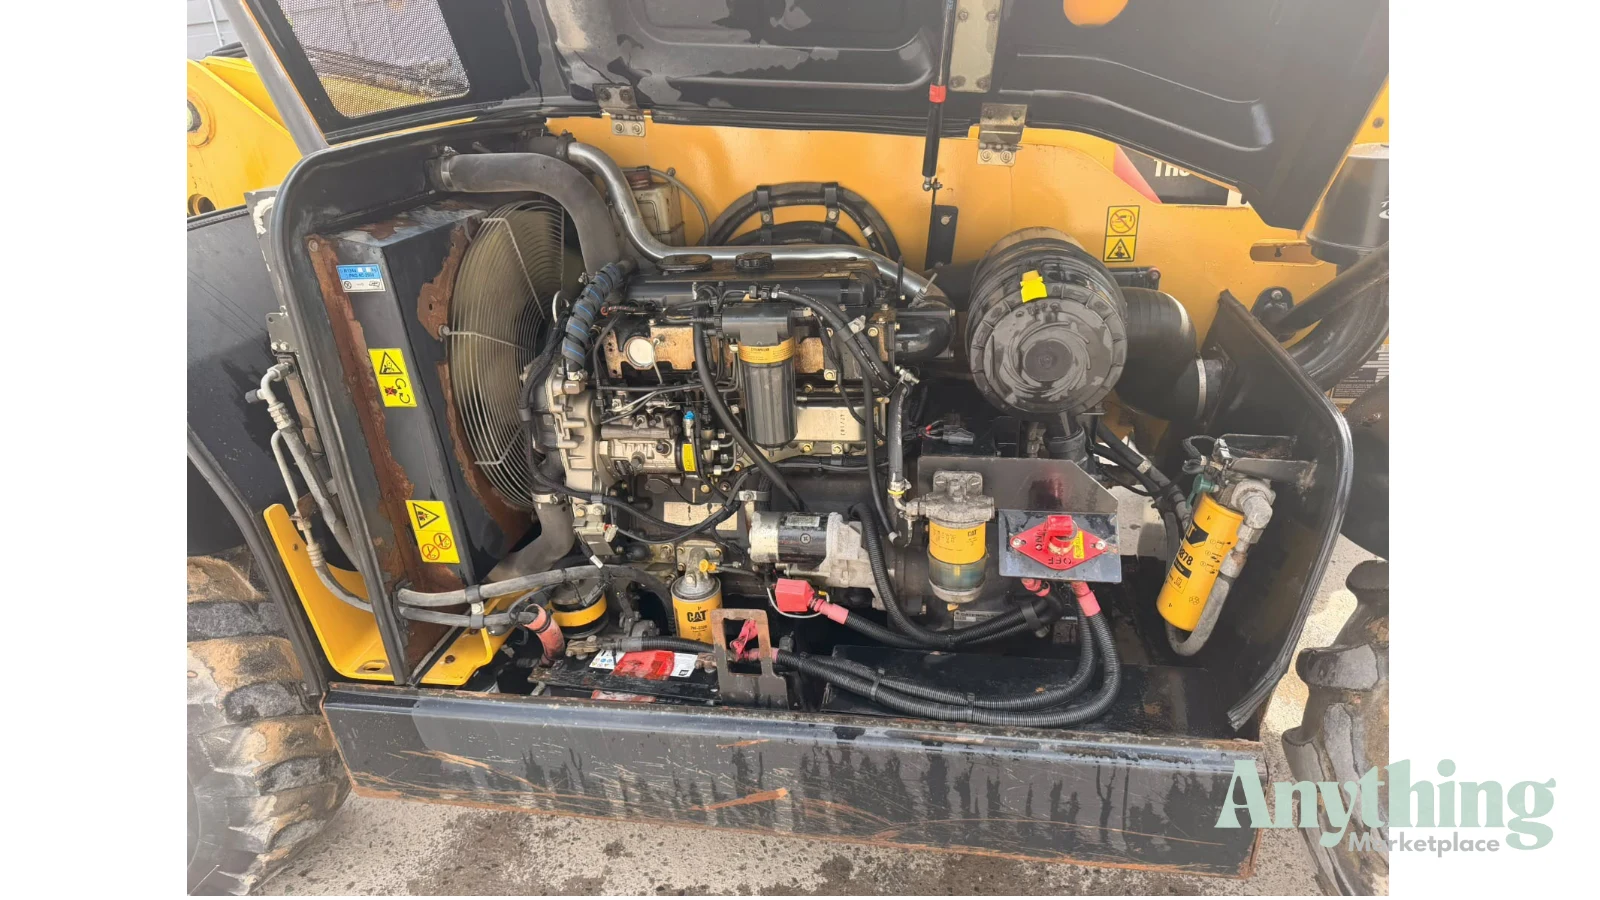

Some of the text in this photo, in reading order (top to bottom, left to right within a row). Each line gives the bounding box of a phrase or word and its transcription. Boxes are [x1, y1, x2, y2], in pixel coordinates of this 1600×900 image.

[1047, 557, 1072, 566] OFF
[1179, 547, 1194, 566] 878
[686, 610, 707, 623] CAT
